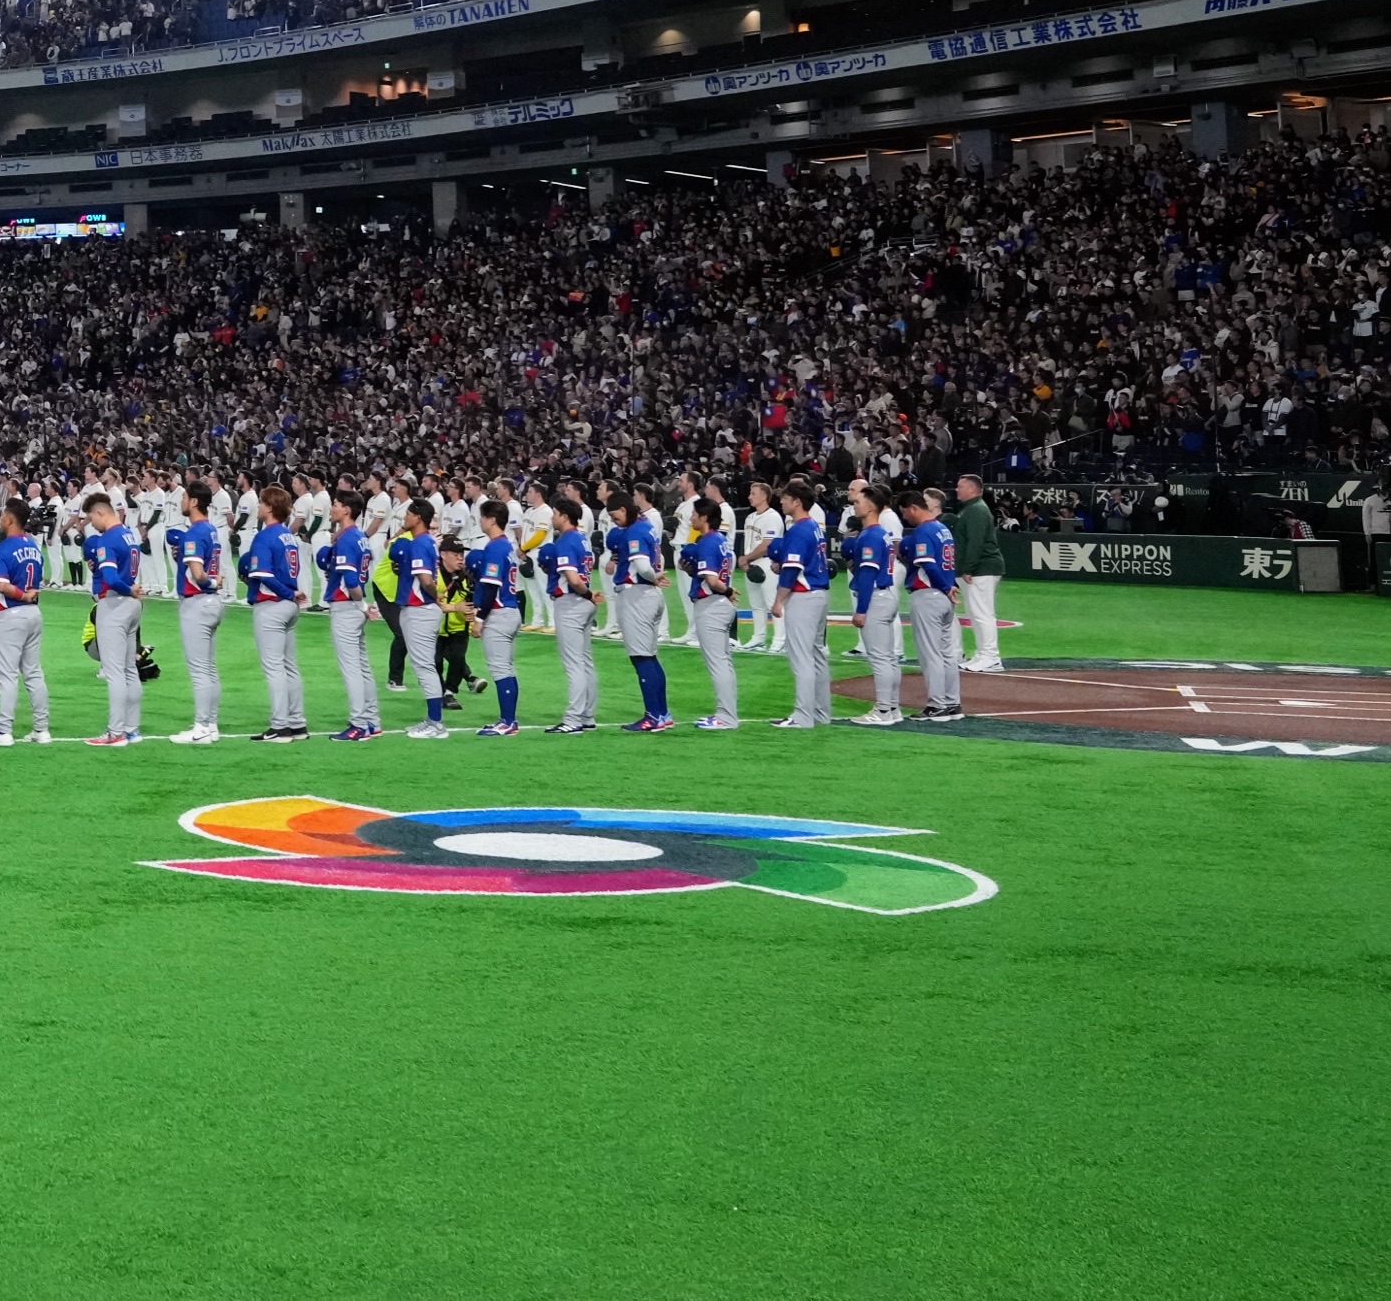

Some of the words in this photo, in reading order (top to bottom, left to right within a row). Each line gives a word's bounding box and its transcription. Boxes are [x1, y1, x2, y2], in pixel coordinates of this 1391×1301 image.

[928, 8, 1142, 61] 電協通信工業株式会社
[61, 58, 165, 83] 蔵王産業株式会社
[1100, 544, 1171, 561] NIPPON
[1100, 558, 1172, 577] EXPRESS
